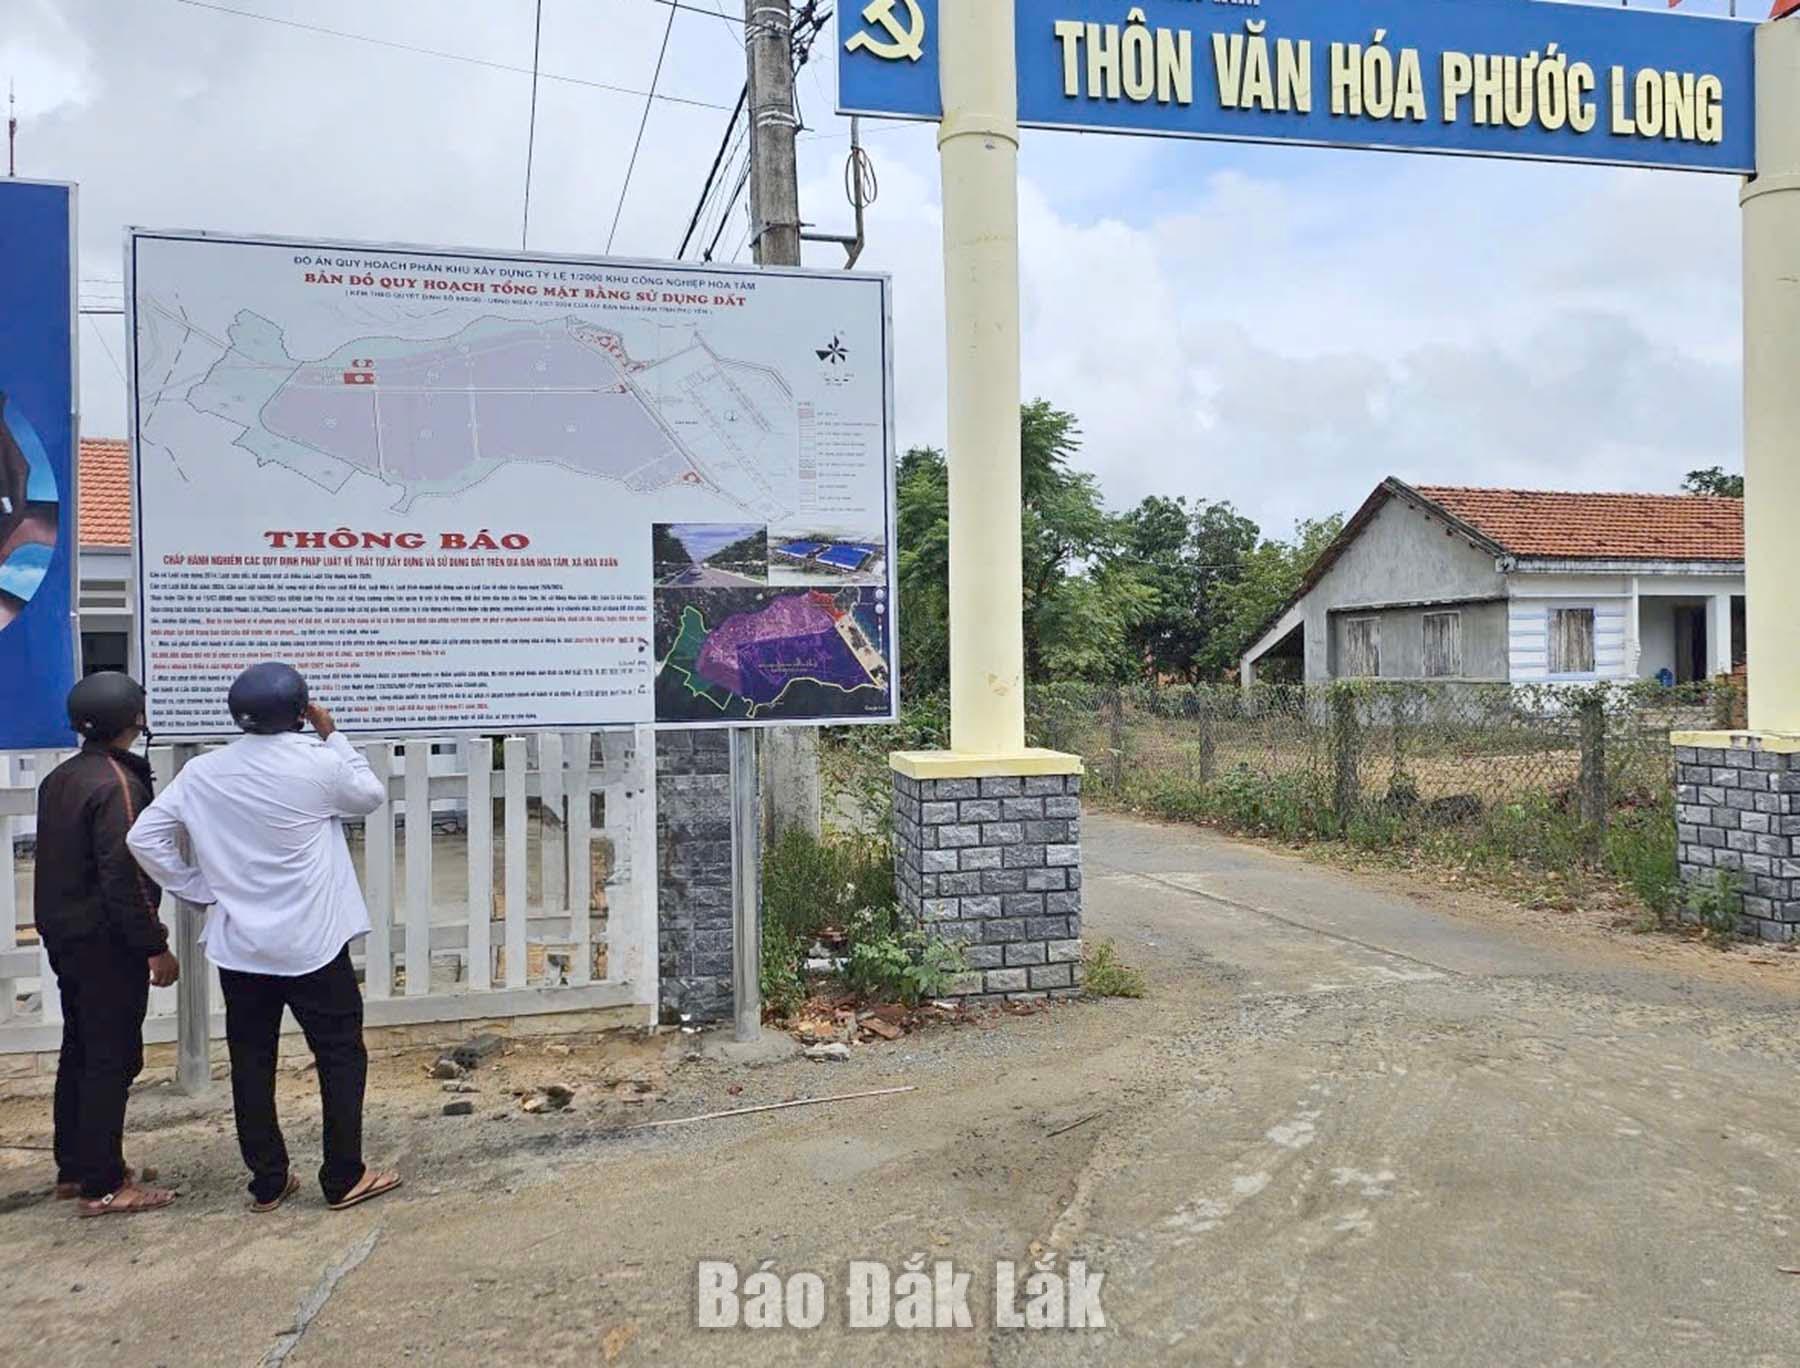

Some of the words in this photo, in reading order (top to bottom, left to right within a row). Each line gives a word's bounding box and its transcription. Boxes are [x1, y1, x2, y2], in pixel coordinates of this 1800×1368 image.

[1054, 9, 1193, 104] THÔN
[1212, 18, 1311, 112] VĂN
[1331, 28, 1426, 121] HÓA
[1443, 42, 1596, 133] PHƯỚC
[1611, 65, 1723, 142] LONG
[336, 257, 361, 268] QUY
[446, 264, 470, 274] KHU
[606, 274, 629, 284] KHU
[304, 270, 343, 285] BẢN
[380, 276, 417, 288] QUY
[424, 279, 485, 294] HOẠCH
[491, 280, 537, 295] TỔNG
[663, 292, 708, 305] DỤNG
[264, 527, 427, 550] THÔNG
[439, 529, 530, 551] BÁO
[263, 556, 278, 567] QUY
